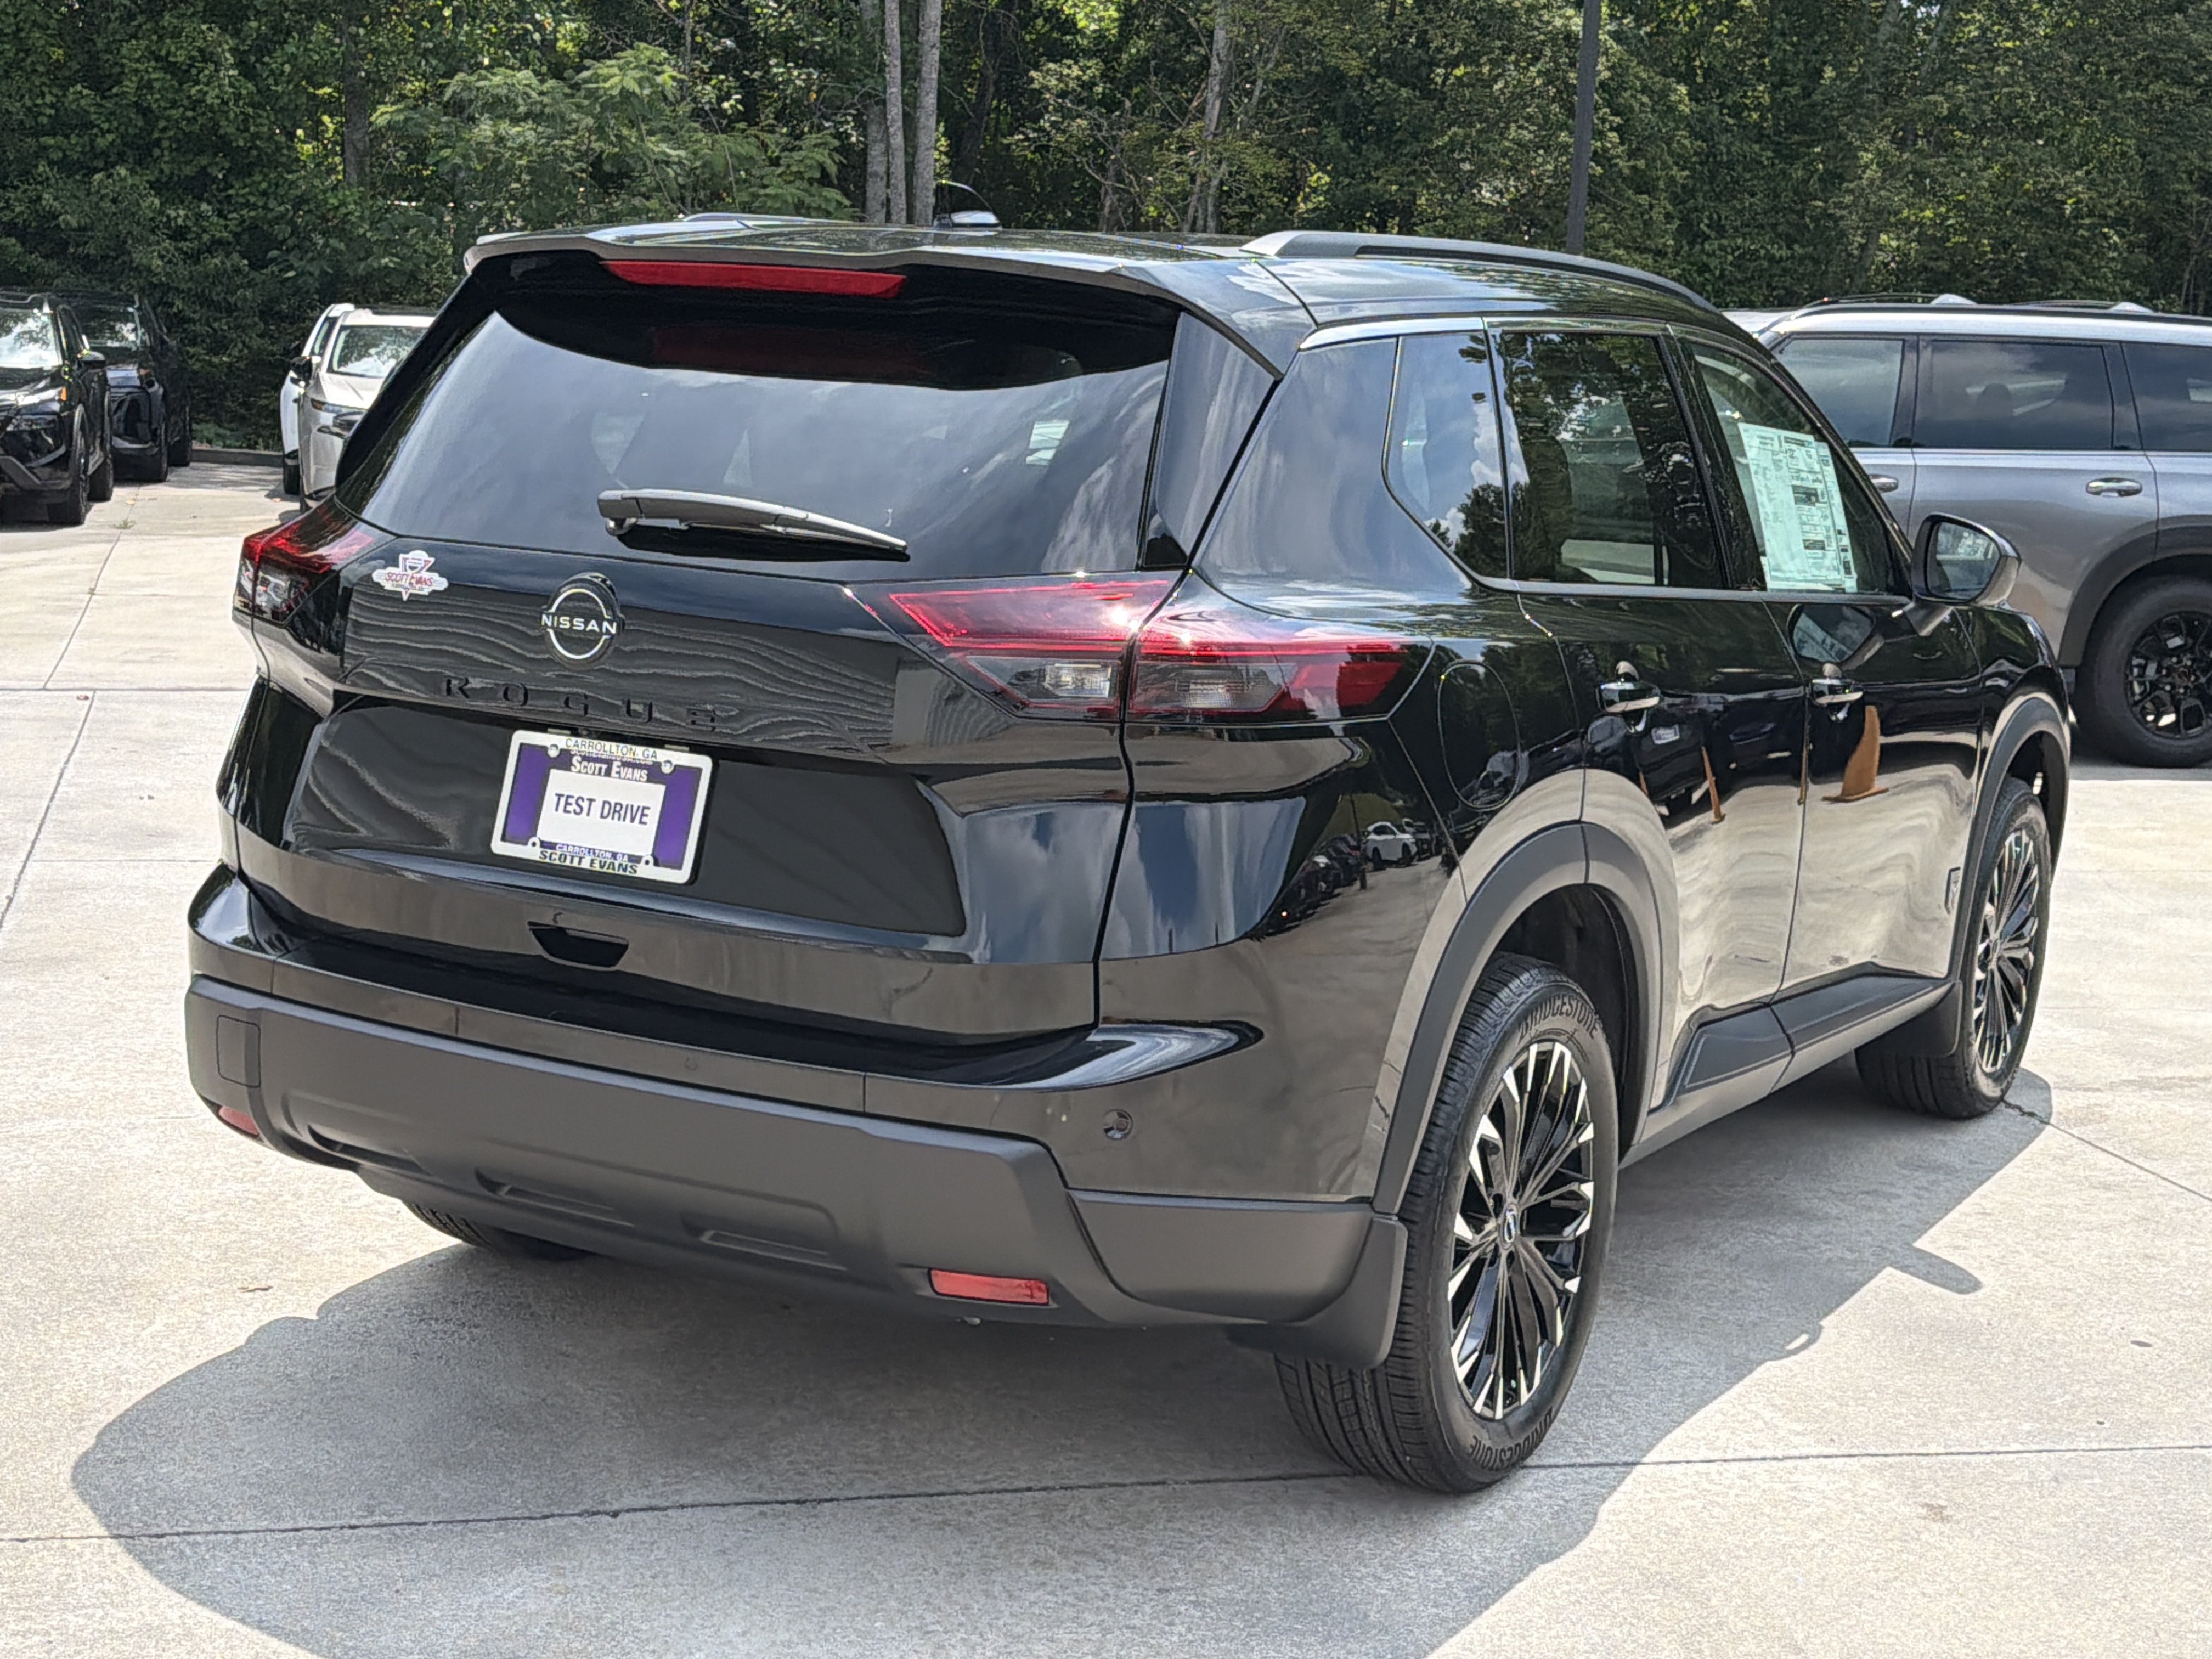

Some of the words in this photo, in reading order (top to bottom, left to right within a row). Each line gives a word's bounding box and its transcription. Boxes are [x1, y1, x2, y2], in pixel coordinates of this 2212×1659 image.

[386, 572, 409, 582] SCOTT
[541, 613, 617, 634] NISSAN
[445, 676, 716, 732] ROGUE
[642, 748, 657, 759] GA
[571, 756, 607, 775] SCOTT
[611, 761, 648, 782] EVANS
[555, 793, 596, 817] TEST
[600, 800, 651, 825] DRIVE
[538, 850, 585, 865] SCOTT
[590, 859, 638, 873] EVANS
[1517, 994, 1598, 1045] BRIDGESTONE
